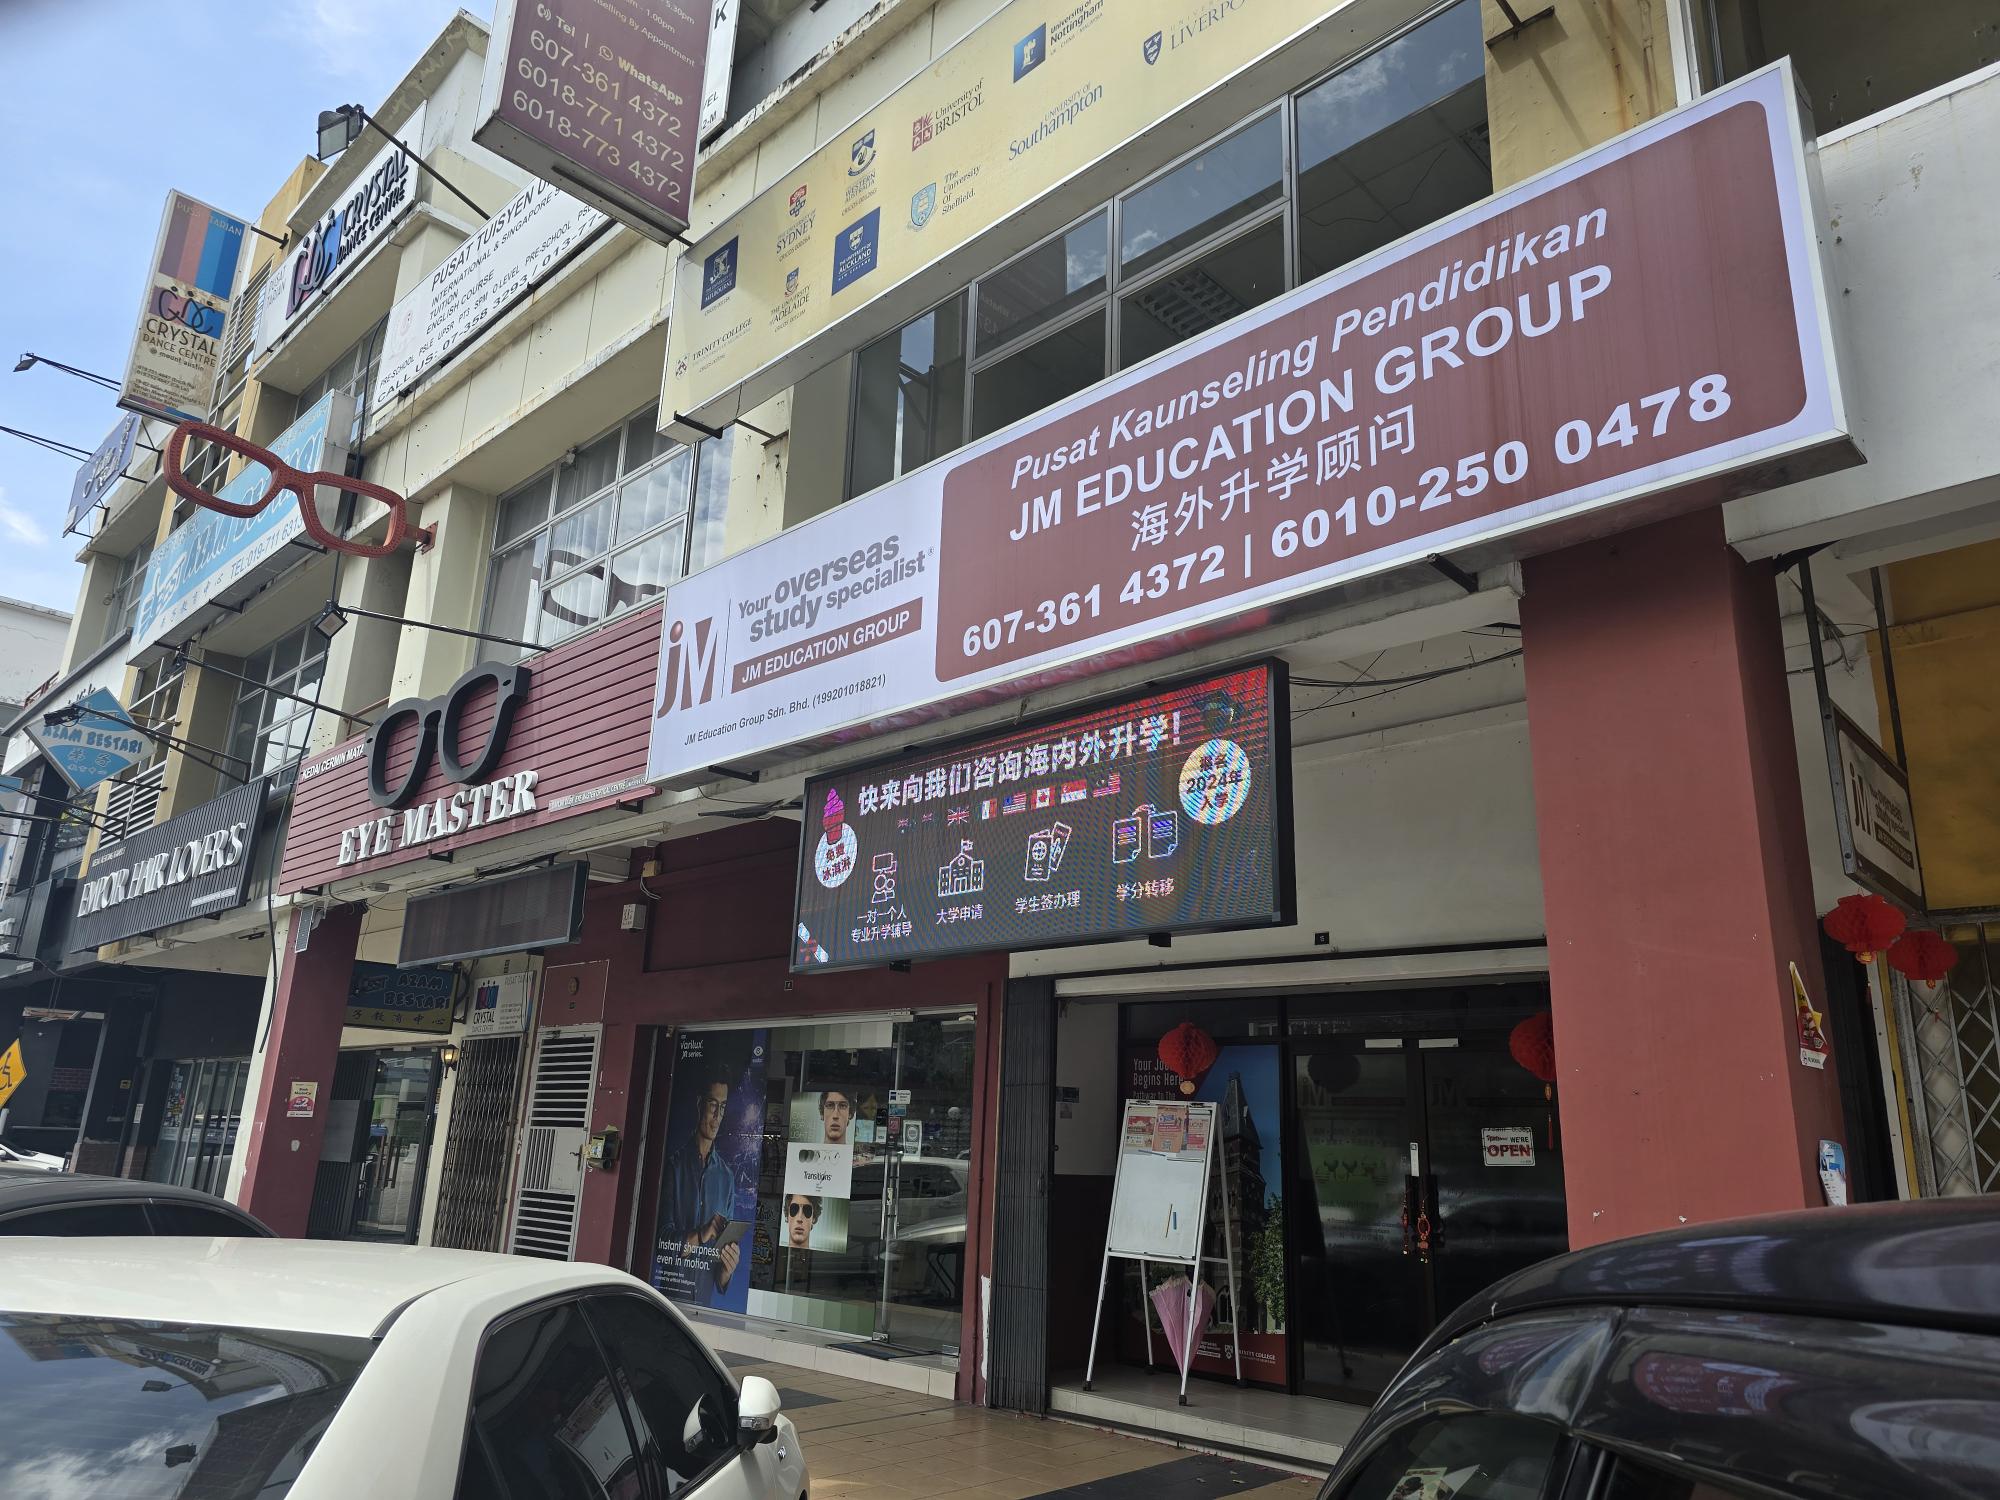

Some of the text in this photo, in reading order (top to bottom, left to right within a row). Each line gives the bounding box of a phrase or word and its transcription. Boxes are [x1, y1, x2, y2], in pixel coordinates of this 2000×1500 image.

[1050, 5, 1084, 34] University
[1050, 0, 1105, 46] Nottingham
[556, 16, 576, 37] Tel
[618, 56, 683, 106] WhatsApp
[629, 18, 695, 66] By Appointment
[530, 30, 681, 138] 607-361 4372
[935, 77, 984, 120] University of
[518, 58, 684, 172] 6018-771 4372
[935, 93, 985, 136] BRISTOL
[1008, 84, 1103, 161] Southampton
[1044, 90, 1083, 122] UNIVERSITY
[513, 90, 680, 203] 6018-773 4372
[343, 140, 409, 237] CRYSTAL
[943, 165, 981, 194] University
[945, 170, 959, 184] The
[369, 178, 407, 231] CENTRE
[431, 254, 492, 307] INTERNATIONAL
[501, 197, 552, 244] SINGAPORE
[432, 188, 536, 291] PUSAT TUISYEN
[776, 214, 815, 254] SYDNEY
[839, 248, 872, 273] AUCKLAND
[418, 338, 434, 355] PSLE
[438, 321, 455, 340] UPSR
[474, 293, 488, 309] SPM
[525, 221, 571, 266] PRE-SCHOOL
[426, 269, 495, 335] ENGLISH COURSE
[774, 294, 810, 323] ADELAIDE
[142, 333, 217, 368] DANCE CENTRE
[146, 318, 218, 357] CRYSTAL
[160, 352, 182, 363] mount
[377, 373, 411, 401] CALL
[415, 351, 439, 373] US:
[442, 308, 488, 351] 07-358
[492, 275, 528, 309] 3293
[692, 336, 721, 360] TRINITY
[722, 317, 752, 342] COLLEGE
[1011, 207, 1608, 489] Pusat Kaunseling Pendidikan
[1009, 264, 1612, 541] JM EDUCATION GROUP
[1130, 404, 1416, 552] 海外升学顾问
[962, 584, 1101, 658] 607-361
[1120, 545, 1225, 605] 4372
[1271, 441, 1529, 558] 6010-250
[1555, 373, 1732, 465] 0478
[738, 535, 900, 619] Your overseas
[750, 594, 823, 643] study
[741, 610, 910, 684] JM EDUCATION GROUP
[684, 673, 886, 746] JM Education Group Sdn. Bhd. (199201018821)
[42, 725, 142, 753] AZAM BESTARI
[303, 763, 321, 779] KEDAI
[321, 751, 347, 772] CERMIN
[337, 770, 540, 866] EYE MASTER
[77, 868, 130, 917] EMPOR
[127, 853, 169, 900] HAIR
[1015, 890, 1081, 913] 学生签办理
[1116, 878, 1174, 901] 学分转移
[850, 921, 912, 942] 专业升学辅导
[856, 904, 907, 924] 一对一个人
[936, 903, 983, 924] 大学申请
[384, 990, 450, 1010] BESTARI
[398, 972, 443, 991] AZAM
[473, 1010, 495, 1025] CRYSTAL
[1133, 1072, 1161, 1089] Begins
[1134, 1058, 1152, 1071] Your
[1487, 1144, 1531, 1157] OPEN
[656, 1254, 673, 1265] even
[675, 1255, 682, 1266] in
[658, 1238, 720, 1260] Instant sharpness,
